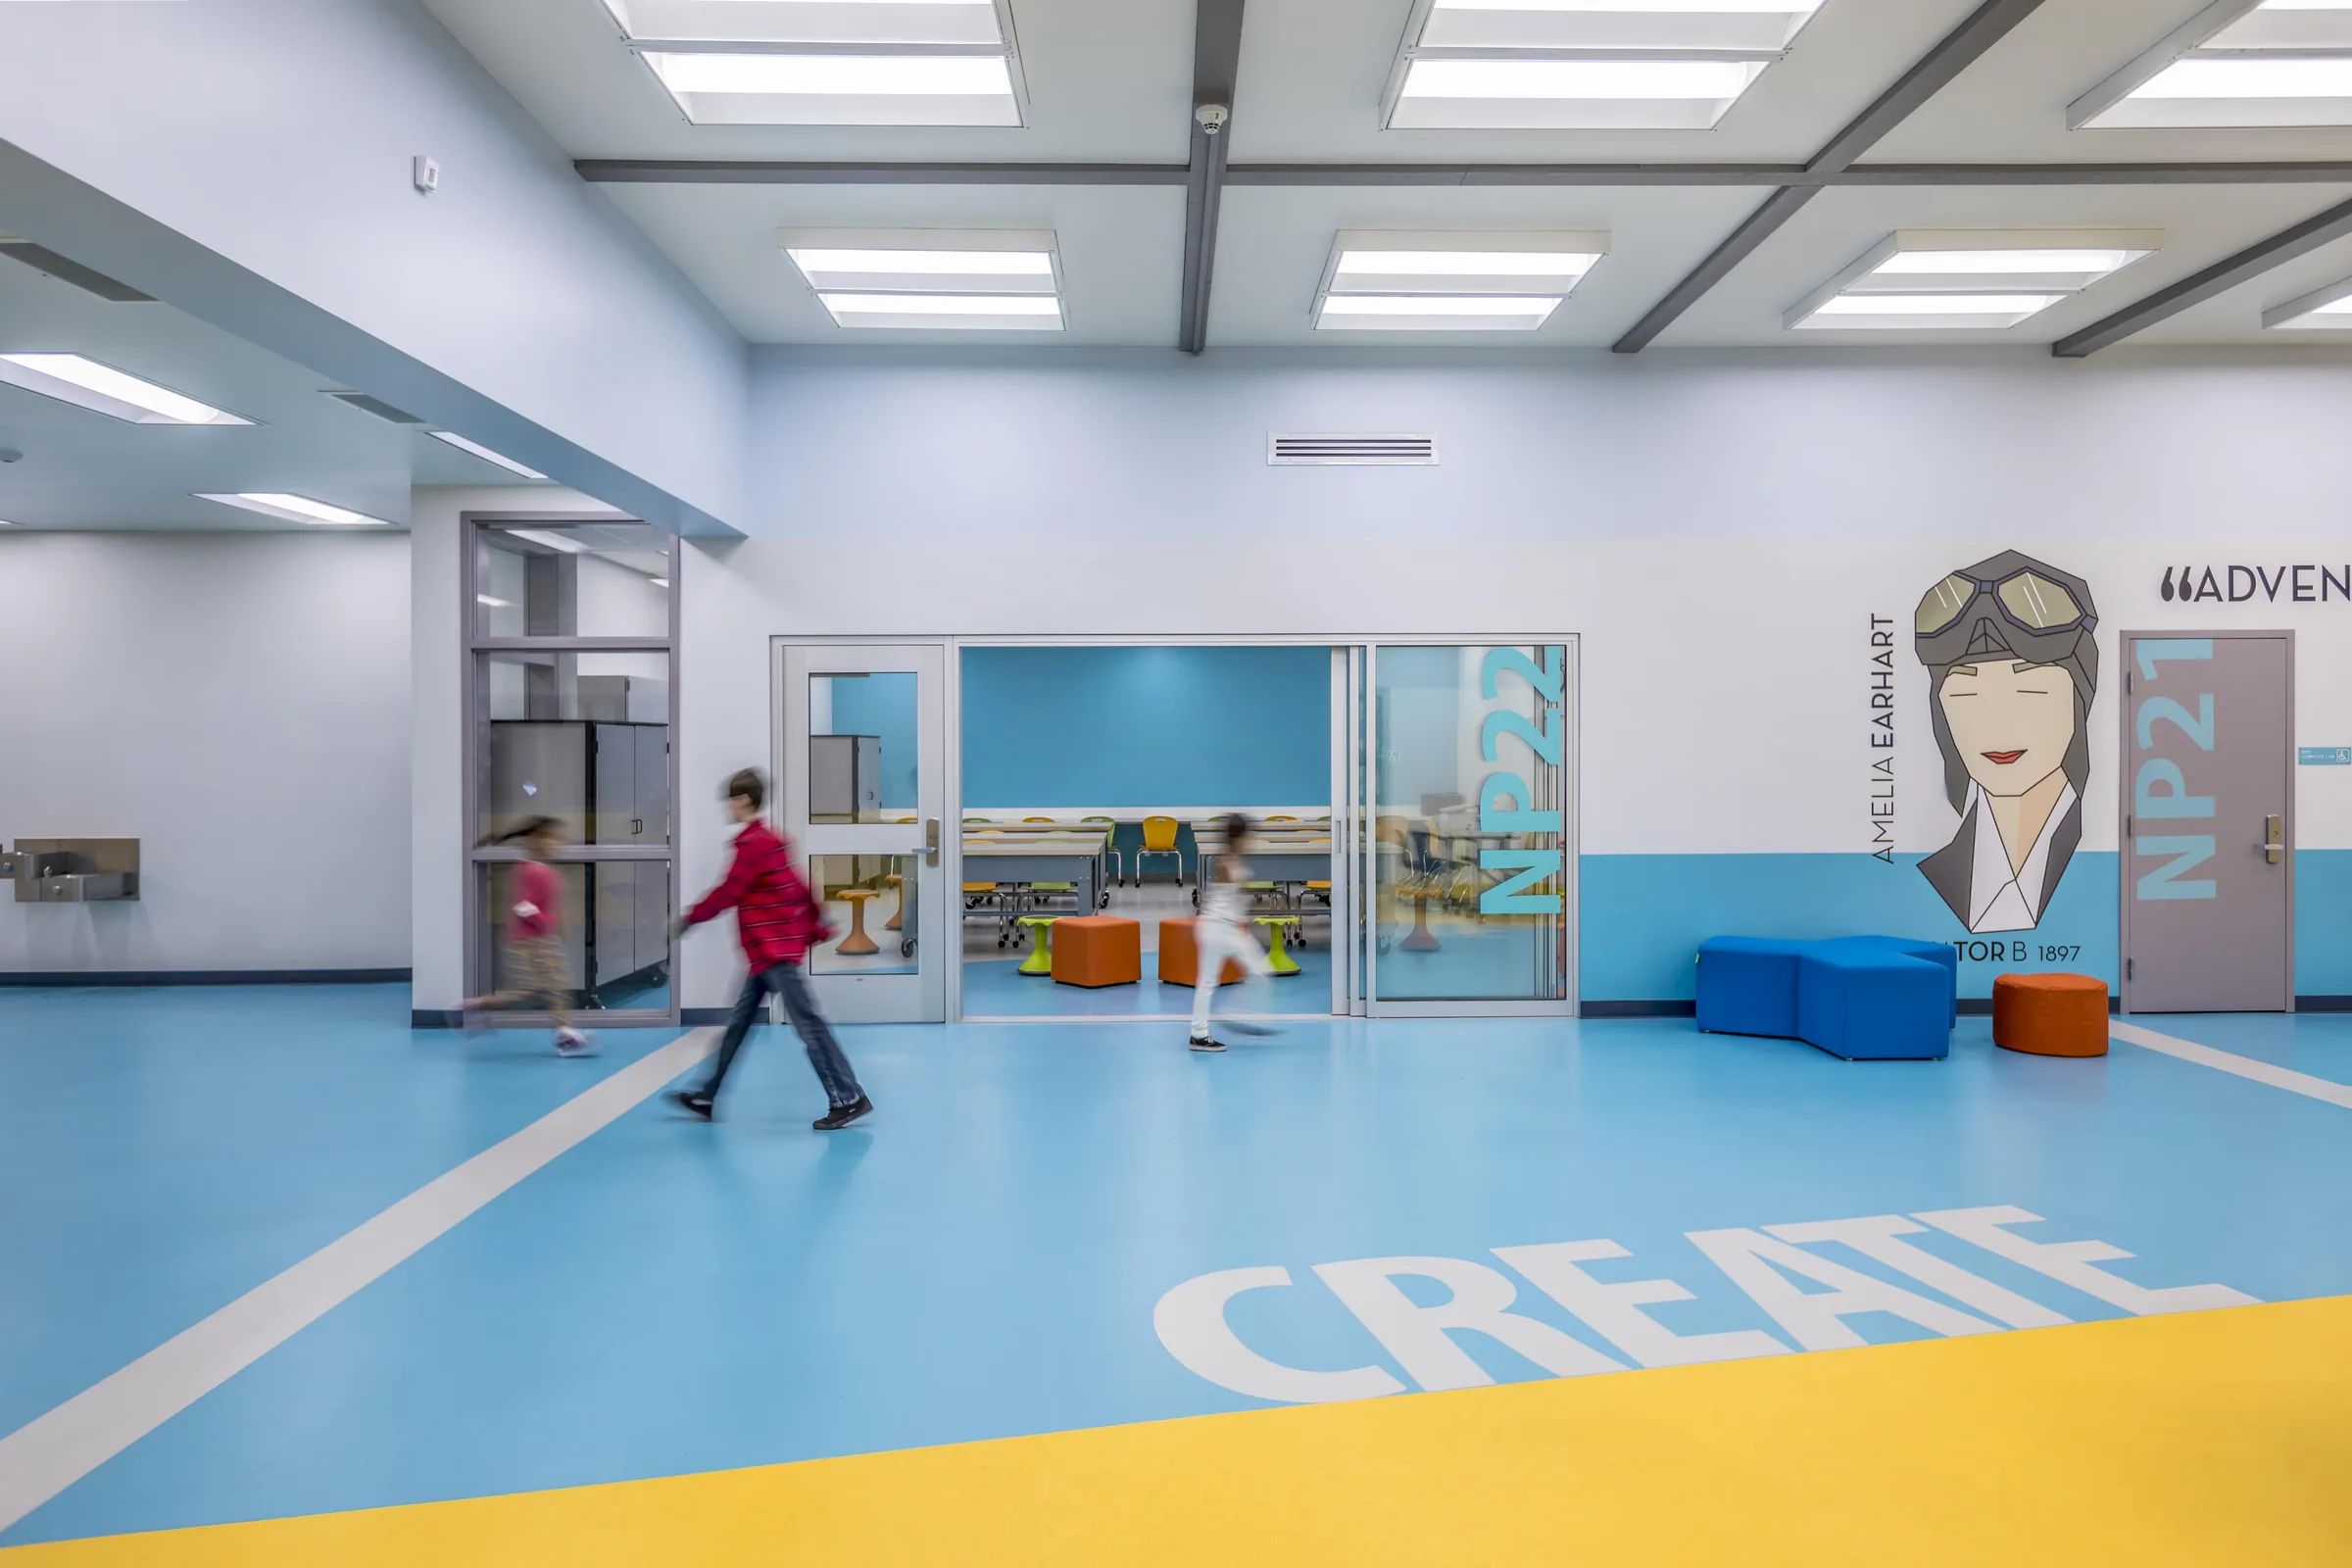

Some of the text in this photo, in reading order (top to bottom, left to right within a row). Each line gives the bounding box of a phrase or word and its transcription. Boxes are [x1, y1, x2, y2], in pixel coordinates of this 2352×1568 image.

[1480, 646, 1562, 914] NP22
[1871, 612, 1894, 864] AMELIA EARHART
[2135, 639, 2217, 901] NP21
[1944, 941, 2081, 962] TOR B 1897
[1153, 1204, 2266, 1402] CREATE
